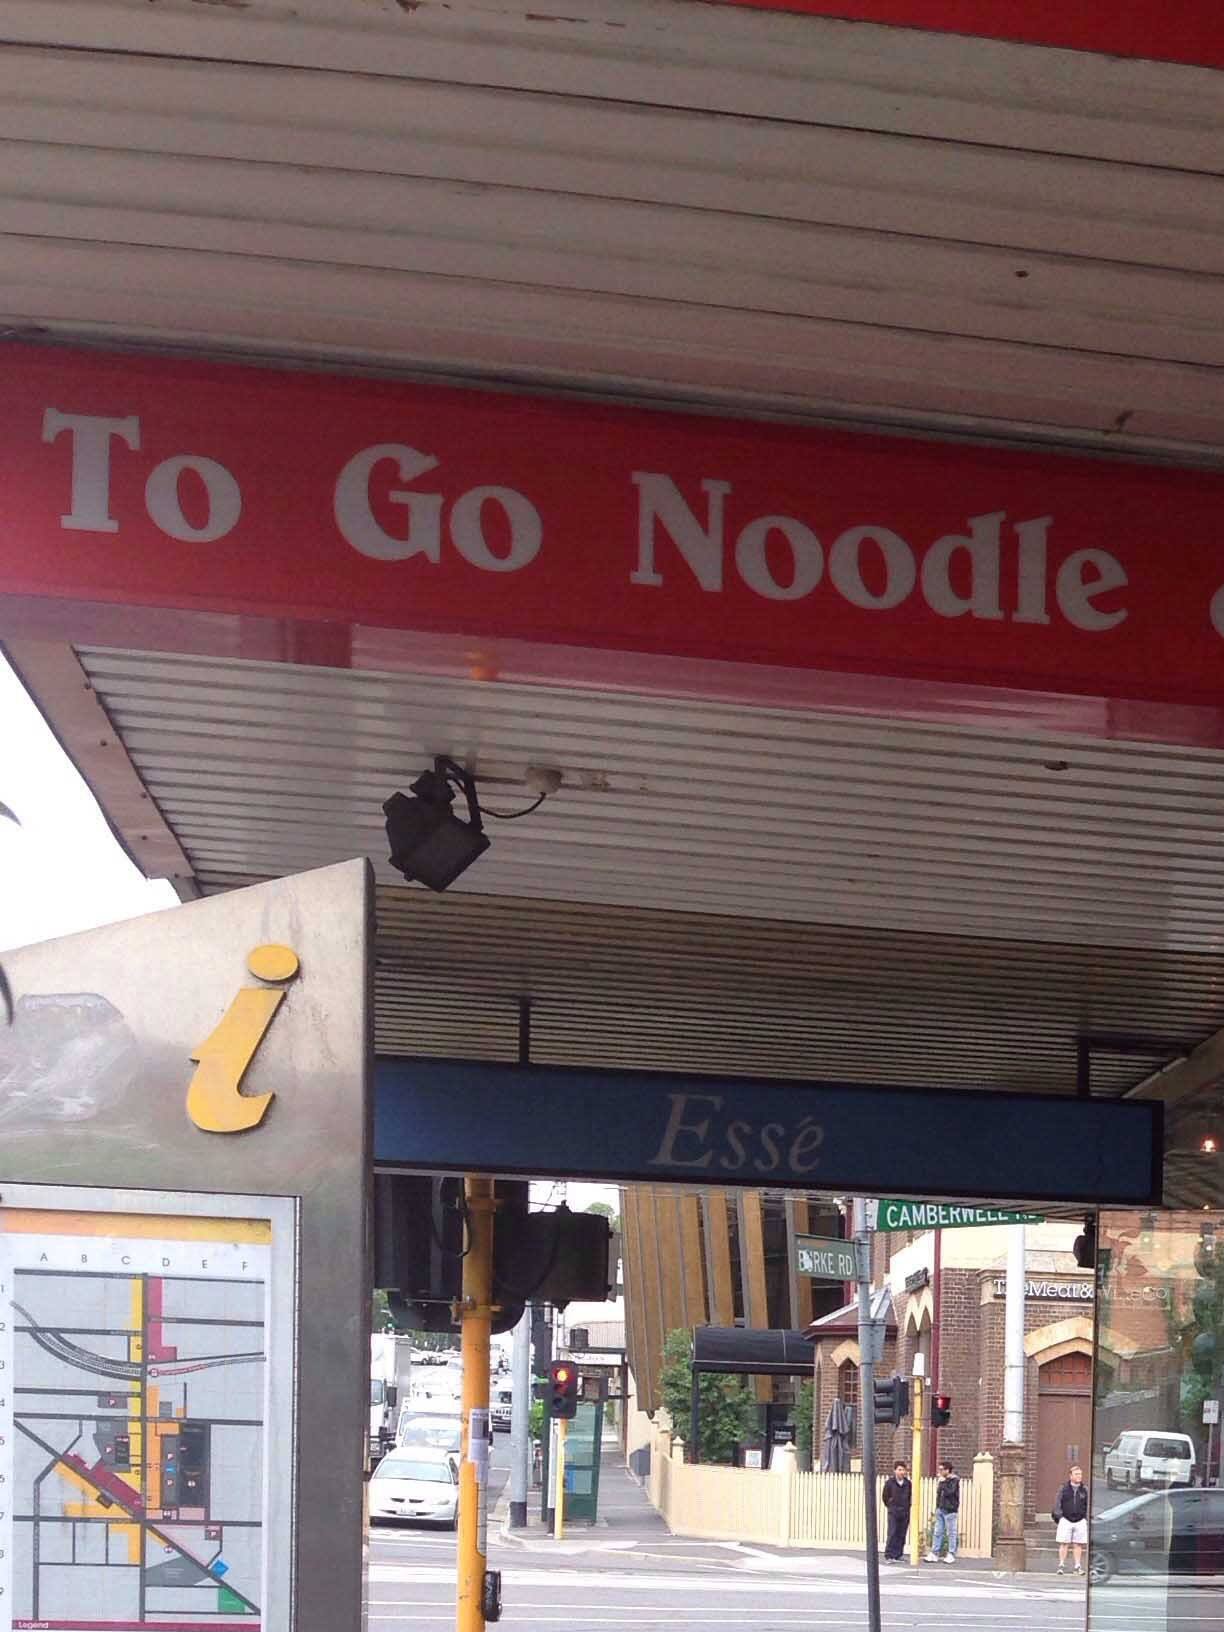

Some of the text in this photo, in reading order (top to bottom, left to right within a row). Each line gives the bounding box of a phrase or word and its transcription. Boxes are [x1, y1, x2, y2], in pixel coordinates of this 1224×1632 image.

[42, 407, 242, 543] To
[333, 443, 543, 573] Go
[630, 471, 1129, 632] Noodle
[649, 1094, 825, 1174] Essé
[40, 1252, 248, 1271] A B C D E F
[839, 1255, 854, 1276] RD
